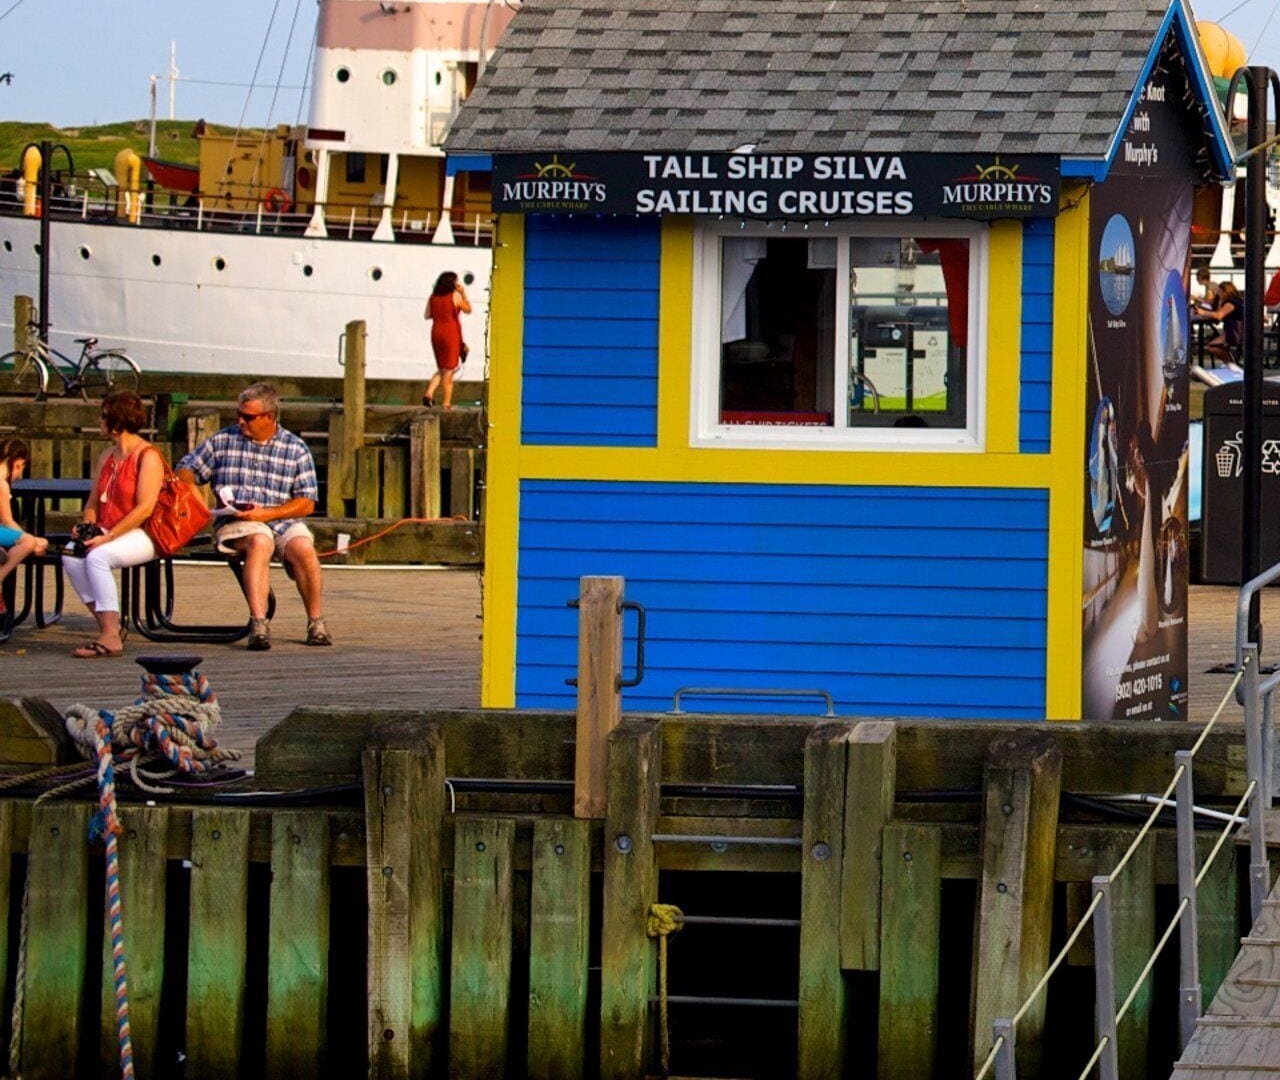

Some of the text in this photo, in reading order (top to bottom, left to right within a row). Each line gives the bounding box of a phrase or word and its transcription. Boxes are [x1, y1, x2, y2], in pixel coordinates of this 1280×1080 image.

[1125, 142, 1158, 167] Murphy's
[644, 155, 907, 180] TALL SHIP SILVA
[503, 180, 607, 204] MURPHY'S
[636, 190, 913, 215] SAILING CRUISES
[942, 183, 1051, 205] MURPHY'S
[1115, 673, 1163, 702] (902) 420-1015
